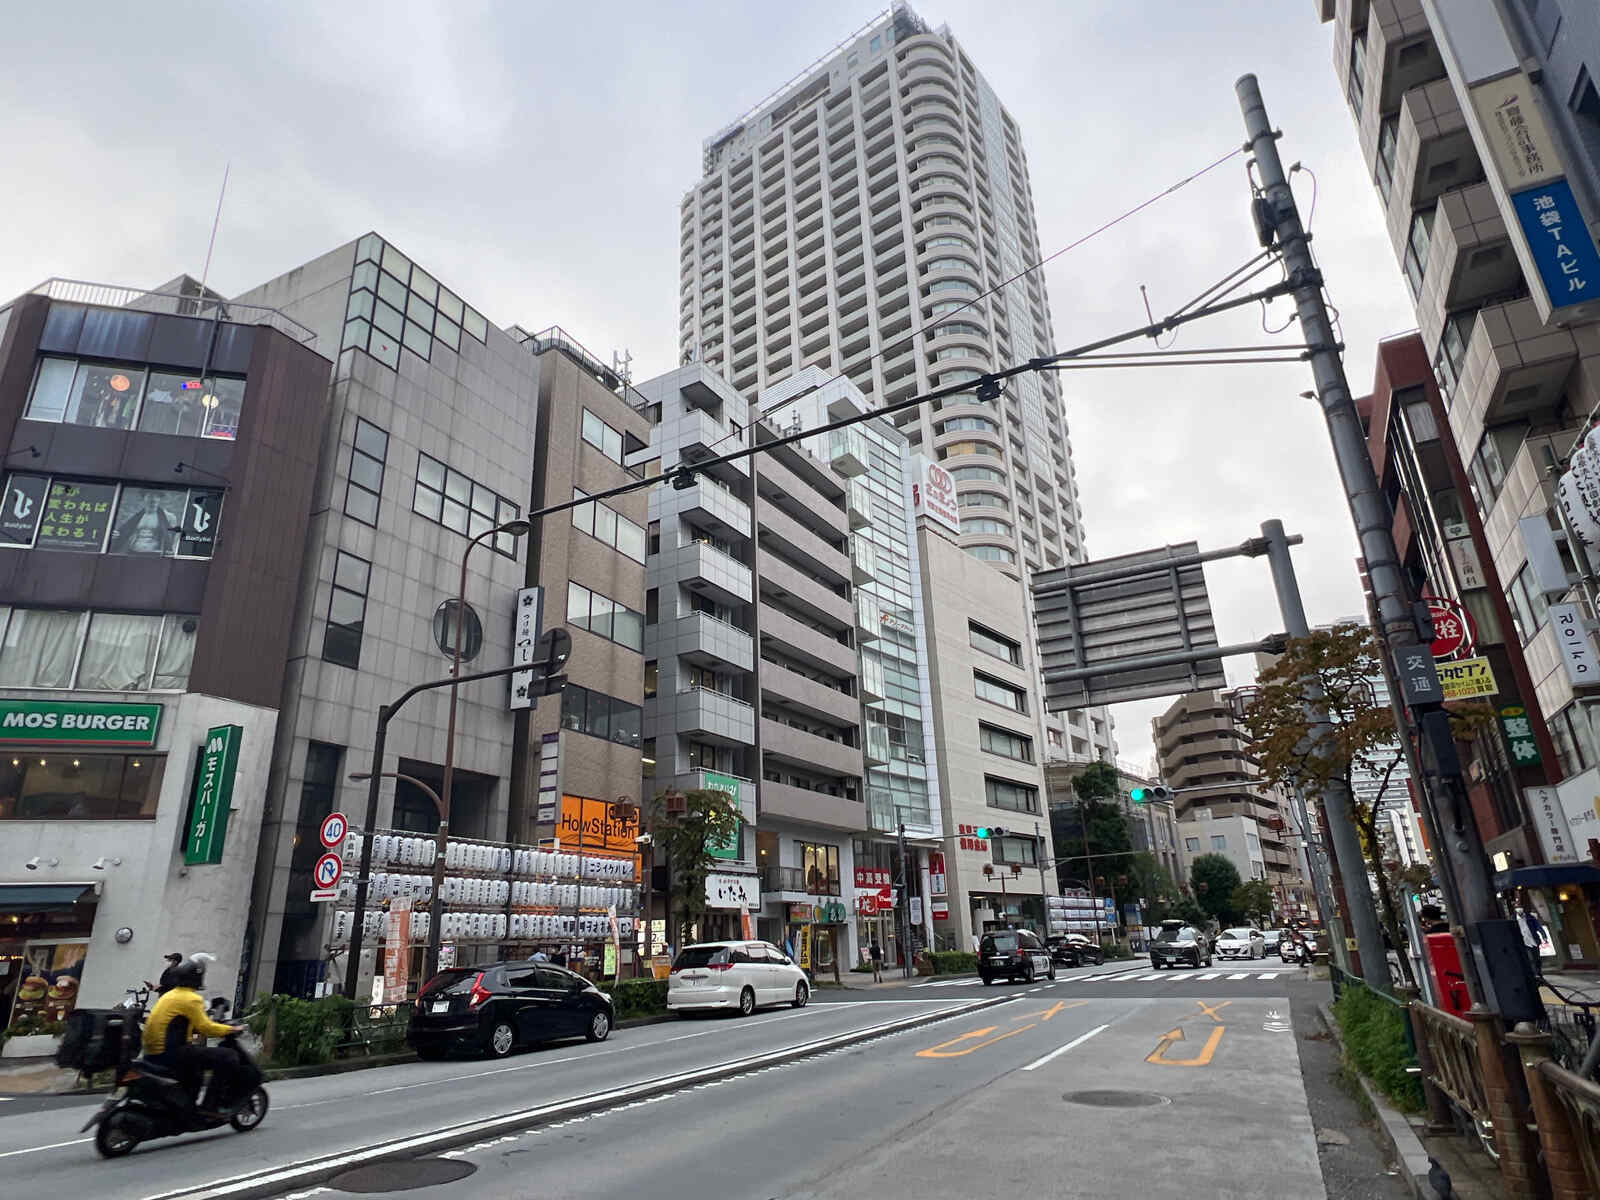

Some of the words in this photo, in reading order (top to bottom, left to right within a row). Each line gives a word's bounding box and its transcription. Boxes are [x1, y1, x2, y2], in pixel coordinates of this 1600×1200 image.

[1533, 195, 1586, 292] 池袋TAビル
[48, 499, 107, 513] 変われば
[44, 512, 88, 524] 人生が
[1434, 619, 1460, 639] 栓
[1406, 655, 1432, 692] 交通
[3, 712, 57, 729] MOS
[61, 713, 151, 731] BURGER
[194, 757, 218, 853] モスバーガー
[326, 823, 341, 838] 40
